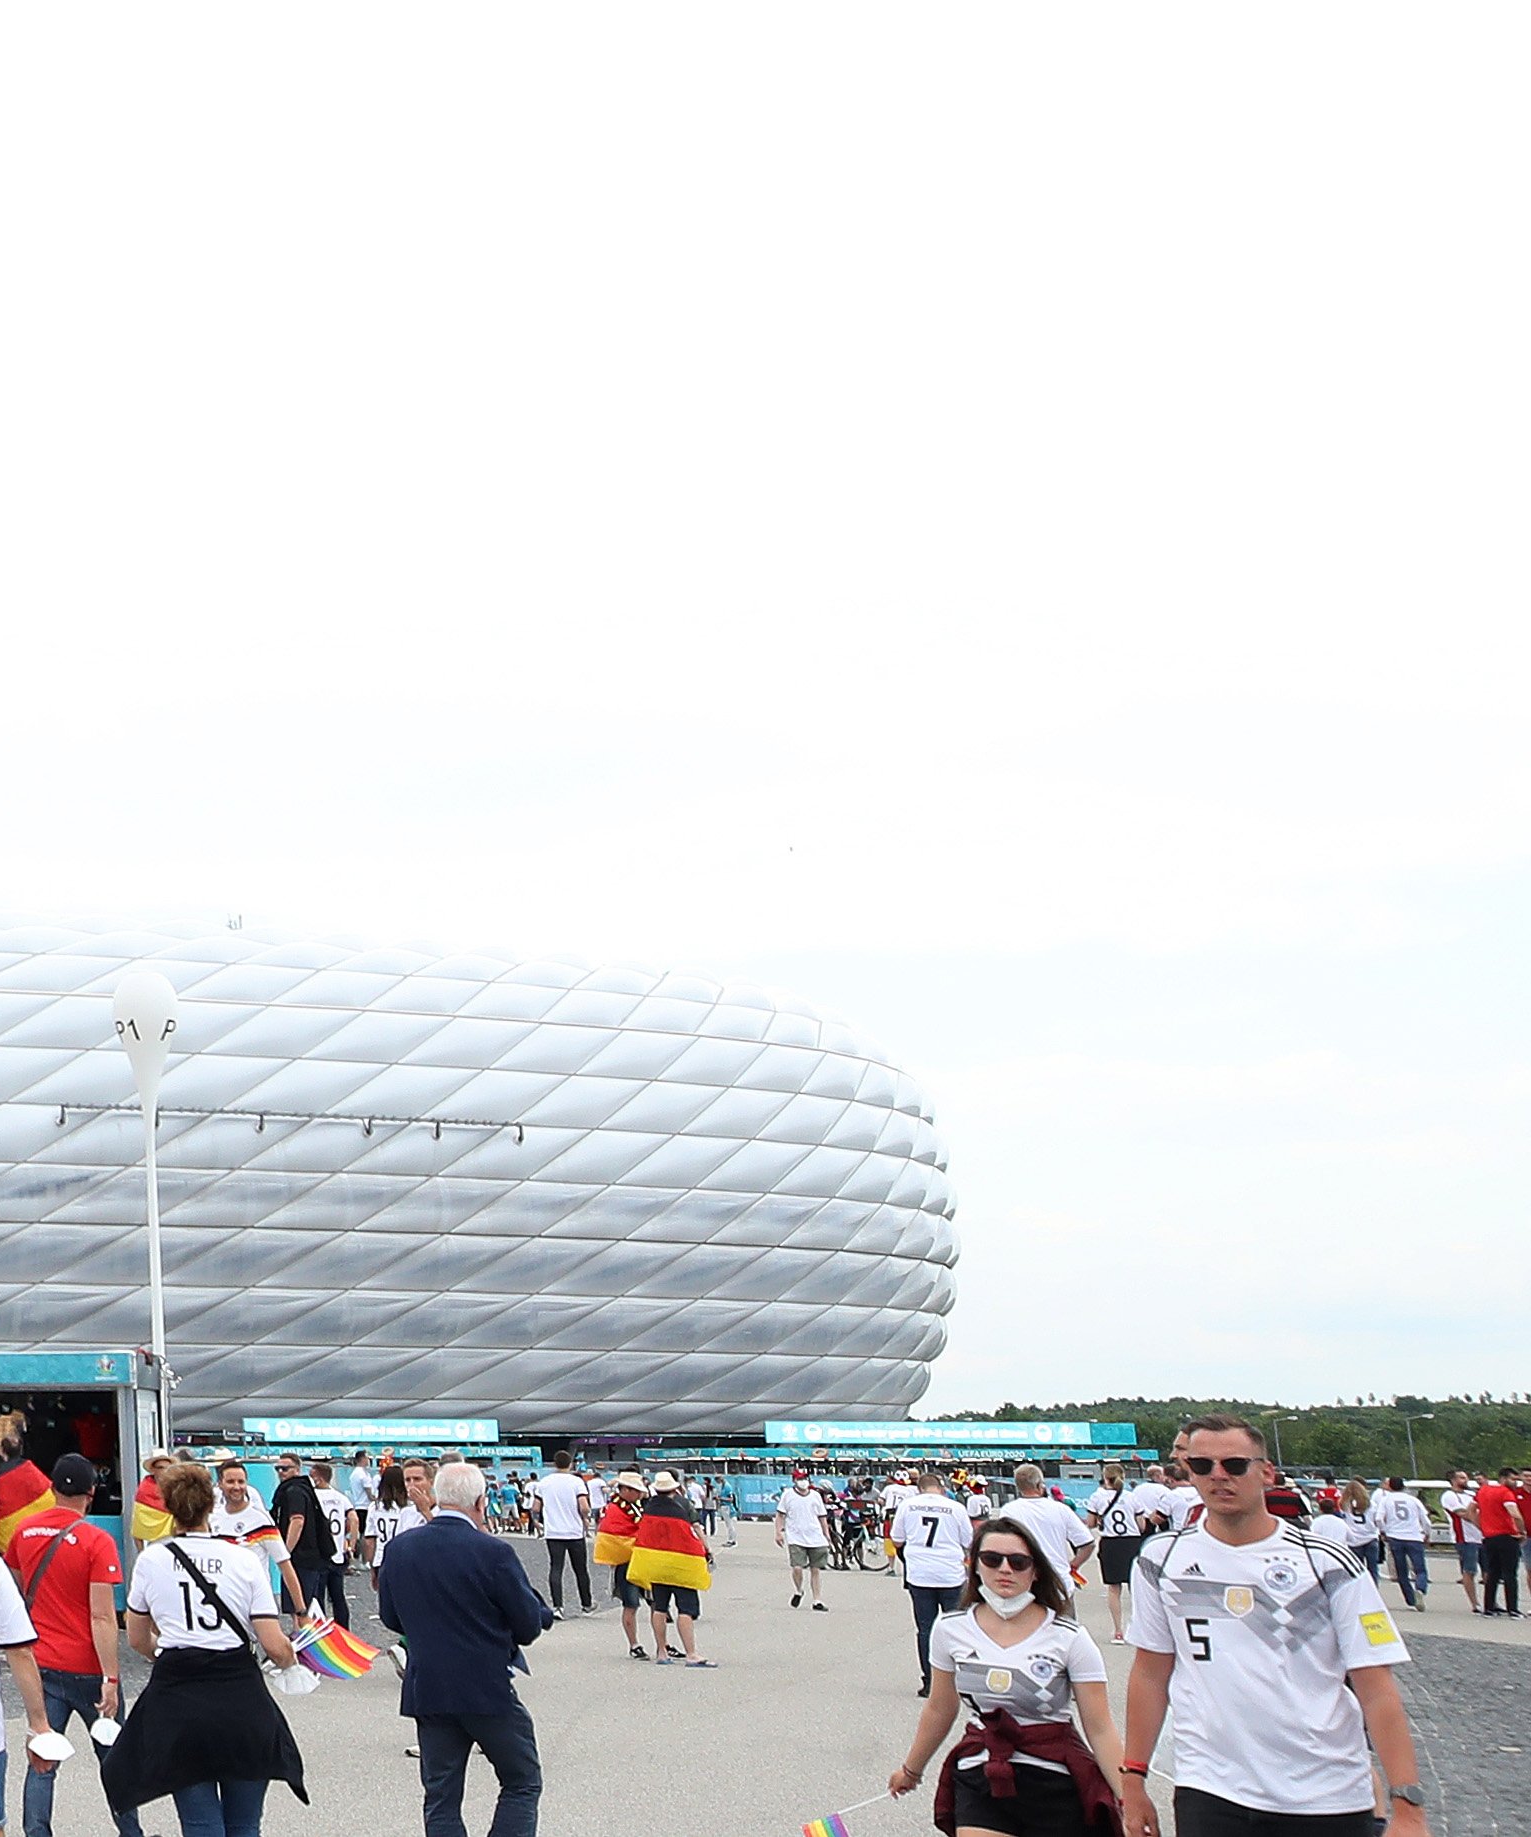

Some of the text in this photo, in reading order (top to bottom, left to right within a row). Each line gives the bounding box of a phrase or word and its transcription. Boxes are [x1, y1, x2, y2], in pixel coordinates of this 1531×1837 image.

[115, 1018, 140, 1041] P1
[160, 1018, 177, 1041] P
[835, 1449, 870, 1458] MUNICH
[1004, 1450, 1025, 1459] 2020
[1394, 1500, 1410, 1521] 5
[377, 1518, 399, 1543] 97
[922, 1516, 940, 1548] 7
[1111, 1510, 1127, 1535] 8
[1185, 1618, 1212, 1662] 5
